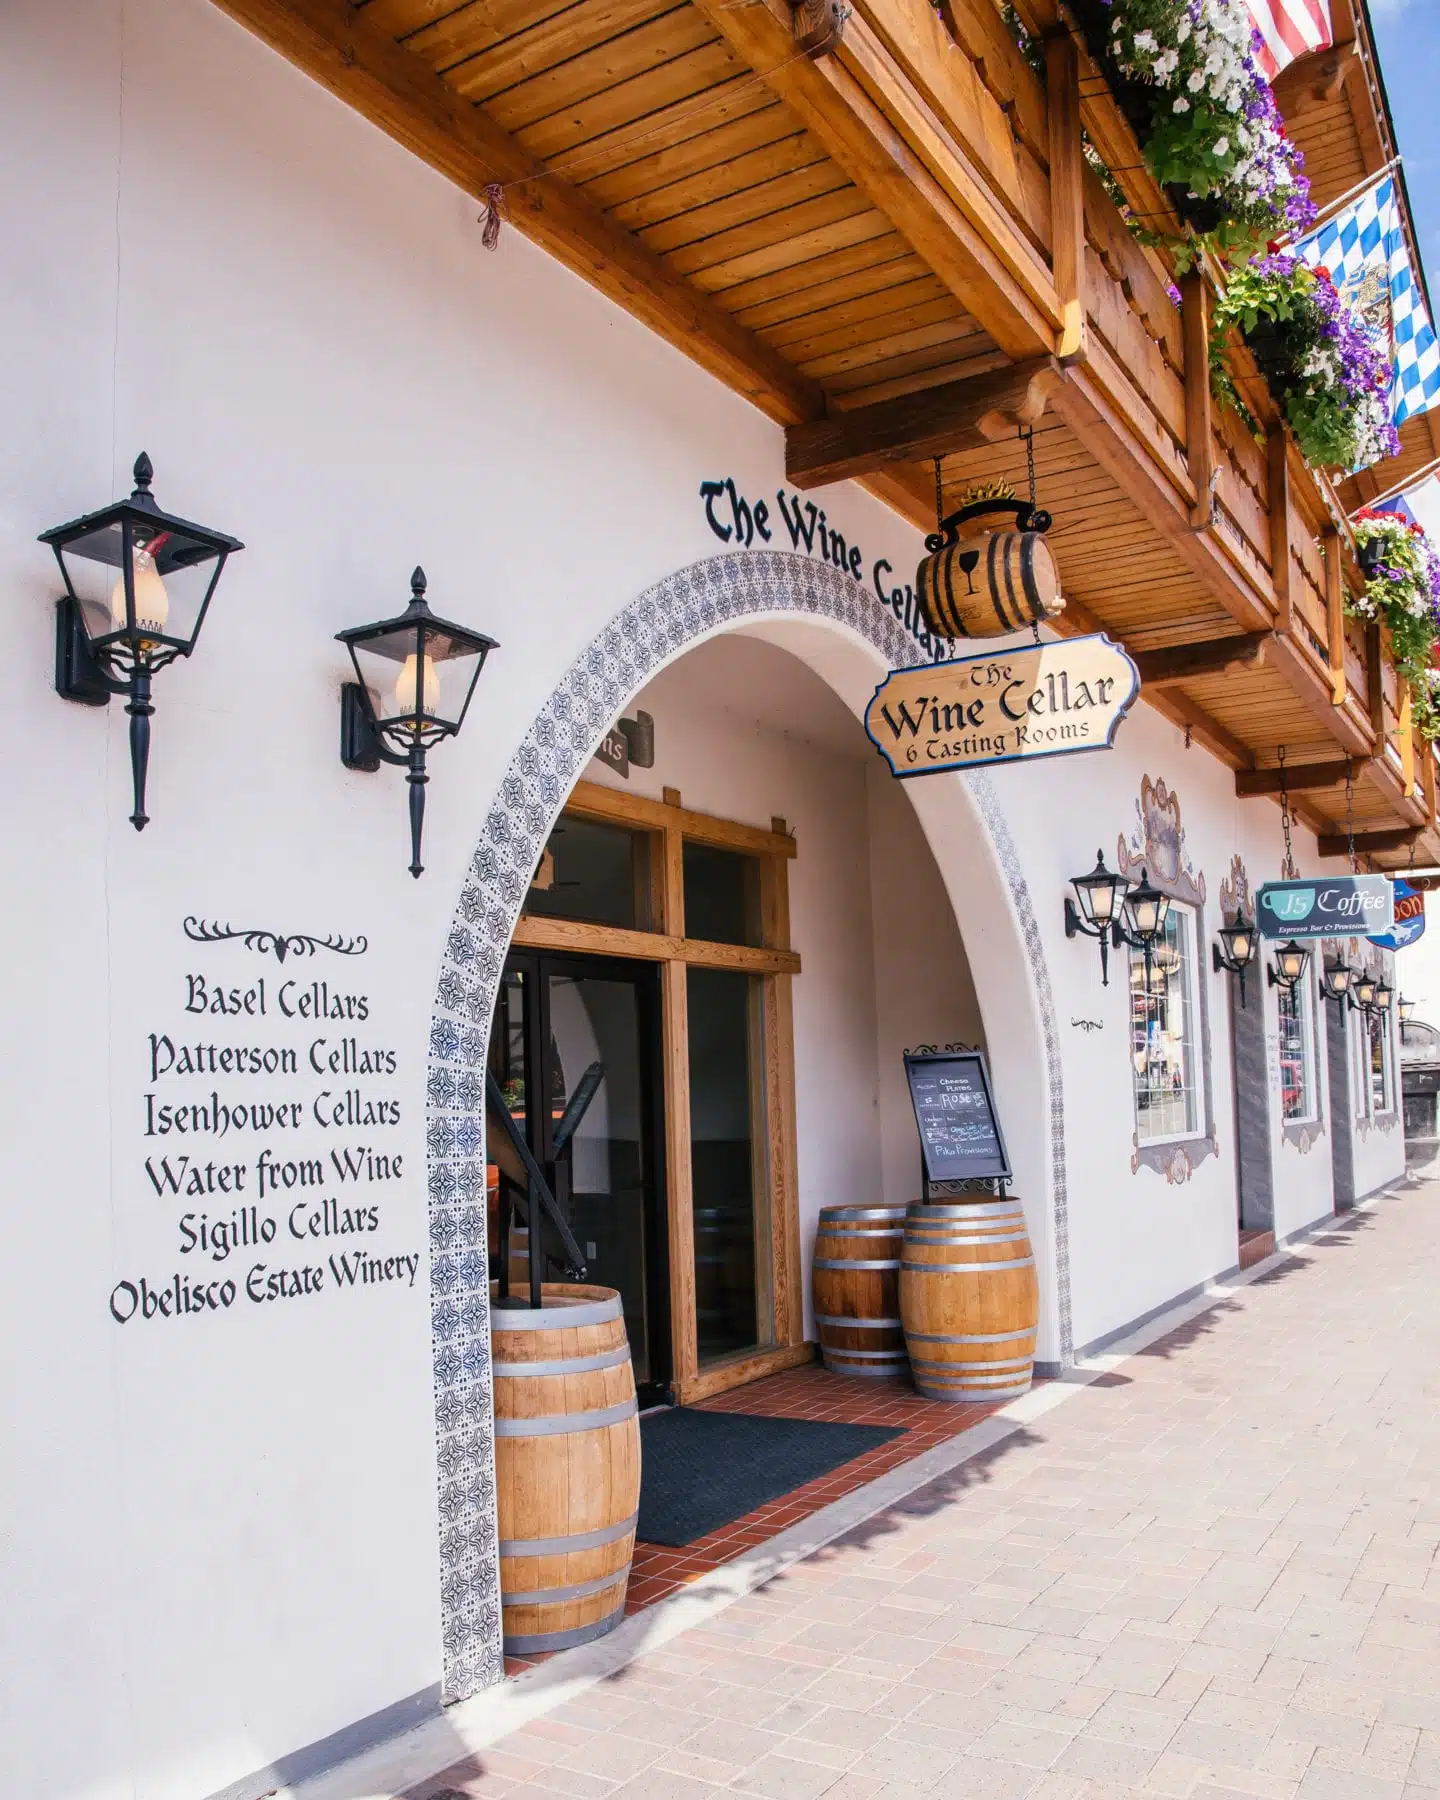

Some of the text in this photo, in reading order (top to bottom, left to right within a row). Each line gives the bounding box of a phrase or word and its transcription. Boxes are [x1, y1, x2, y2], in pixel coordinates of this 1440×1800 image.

[700, 477, 945, 662] The Wine Cellar
[970, 663, 1013, 688] The
[880, 670, 1115, 741] Wine Cellar
[906, 721, 1090, 763] 6 Tasting Rooms
[1280, 889, 1386, 916] J5 Coffee
[1278, 926, 1308, 935] Espresso
[1334, 923, 1373, 931] Provisions
[185, 974, 369, 1021] Basel Cellars
[147, 1032, 397, 1082] Patterson Cellars
[143, 1089, 401, 1138] Isenhower Cellars
[145, 1146, 403, 1198] Water from Wine
[178, 1197, 379, 1261] Sigillo Cellars
[110, 1250, 420, 1324] Obelisco Estate Winery
